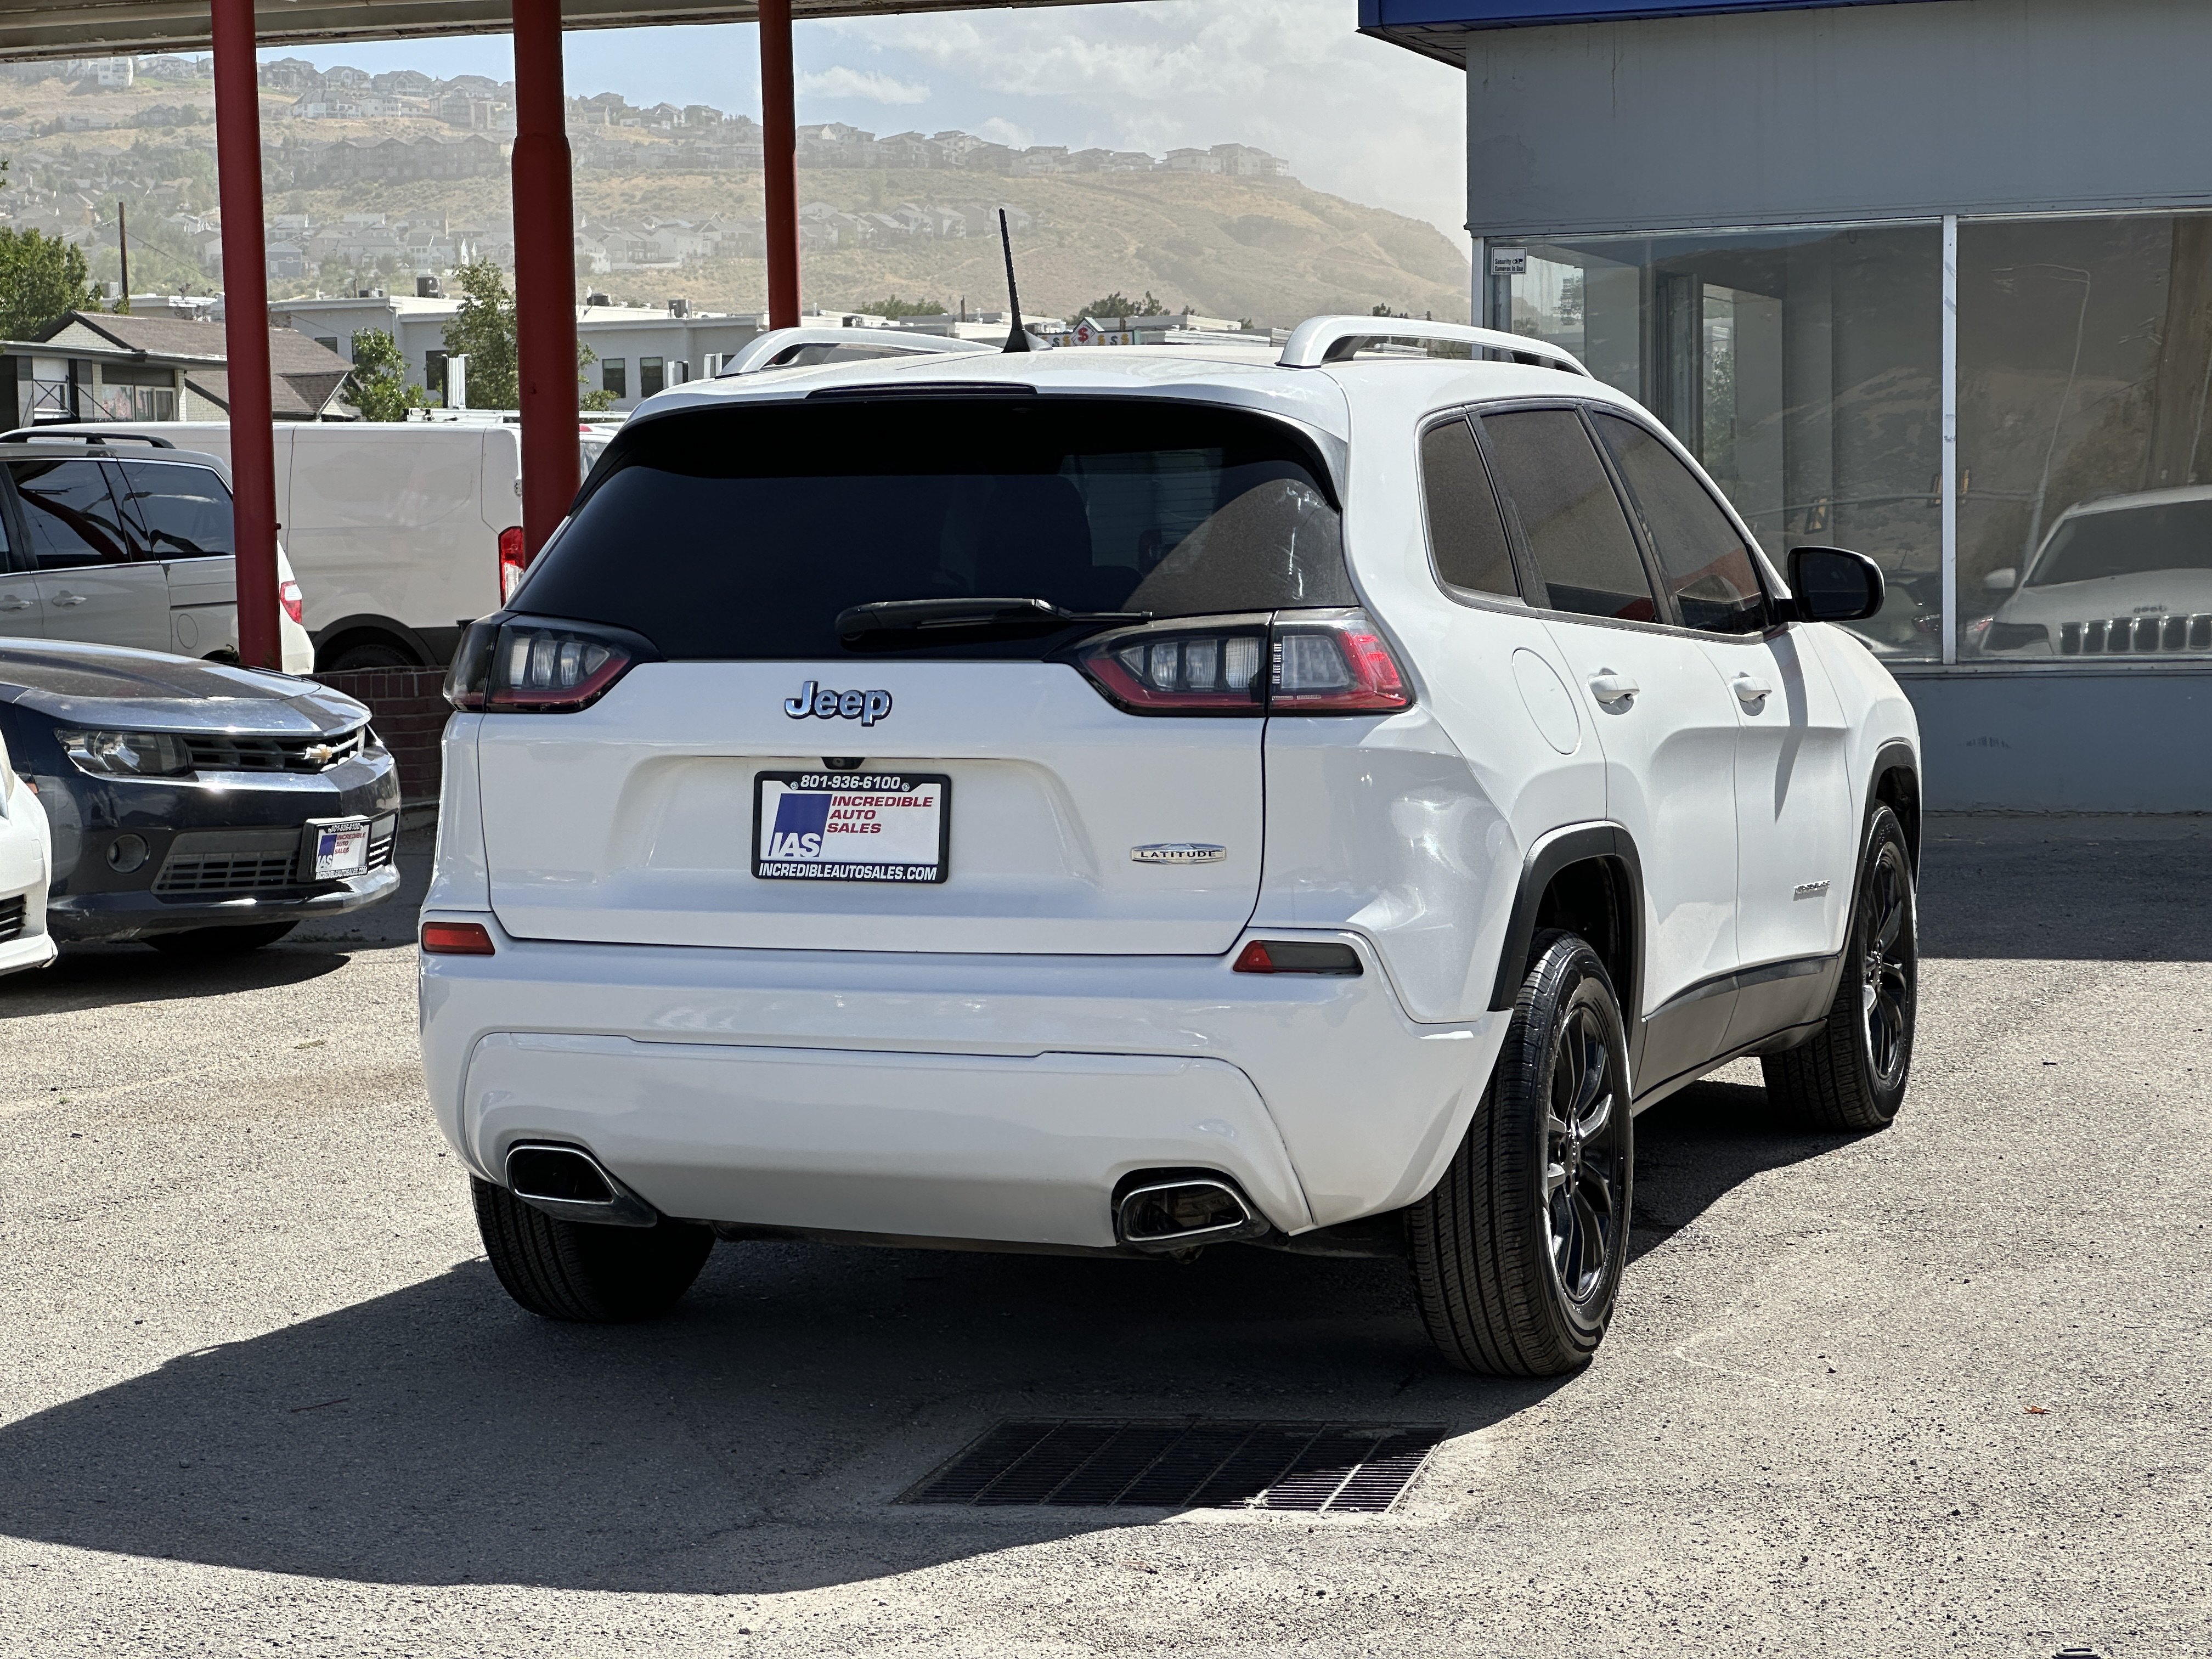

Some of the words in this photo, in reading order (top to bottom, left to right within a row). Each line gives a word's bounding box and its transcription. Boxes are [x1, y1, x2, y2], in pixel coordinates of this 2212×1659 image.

[785, 681, 893, 727] Jeep
[800, 775, 901, 790] 801-936-6100
[832, 796, 934, 808] INCREDIBLE
[829, 809, 876, 820] AUTO
[827, 823, 882, 833] SALES
[770, 832, 821, 857] IAS
[759, 862, 937, 881] INCREDIBLEAUTOSALES.COM
